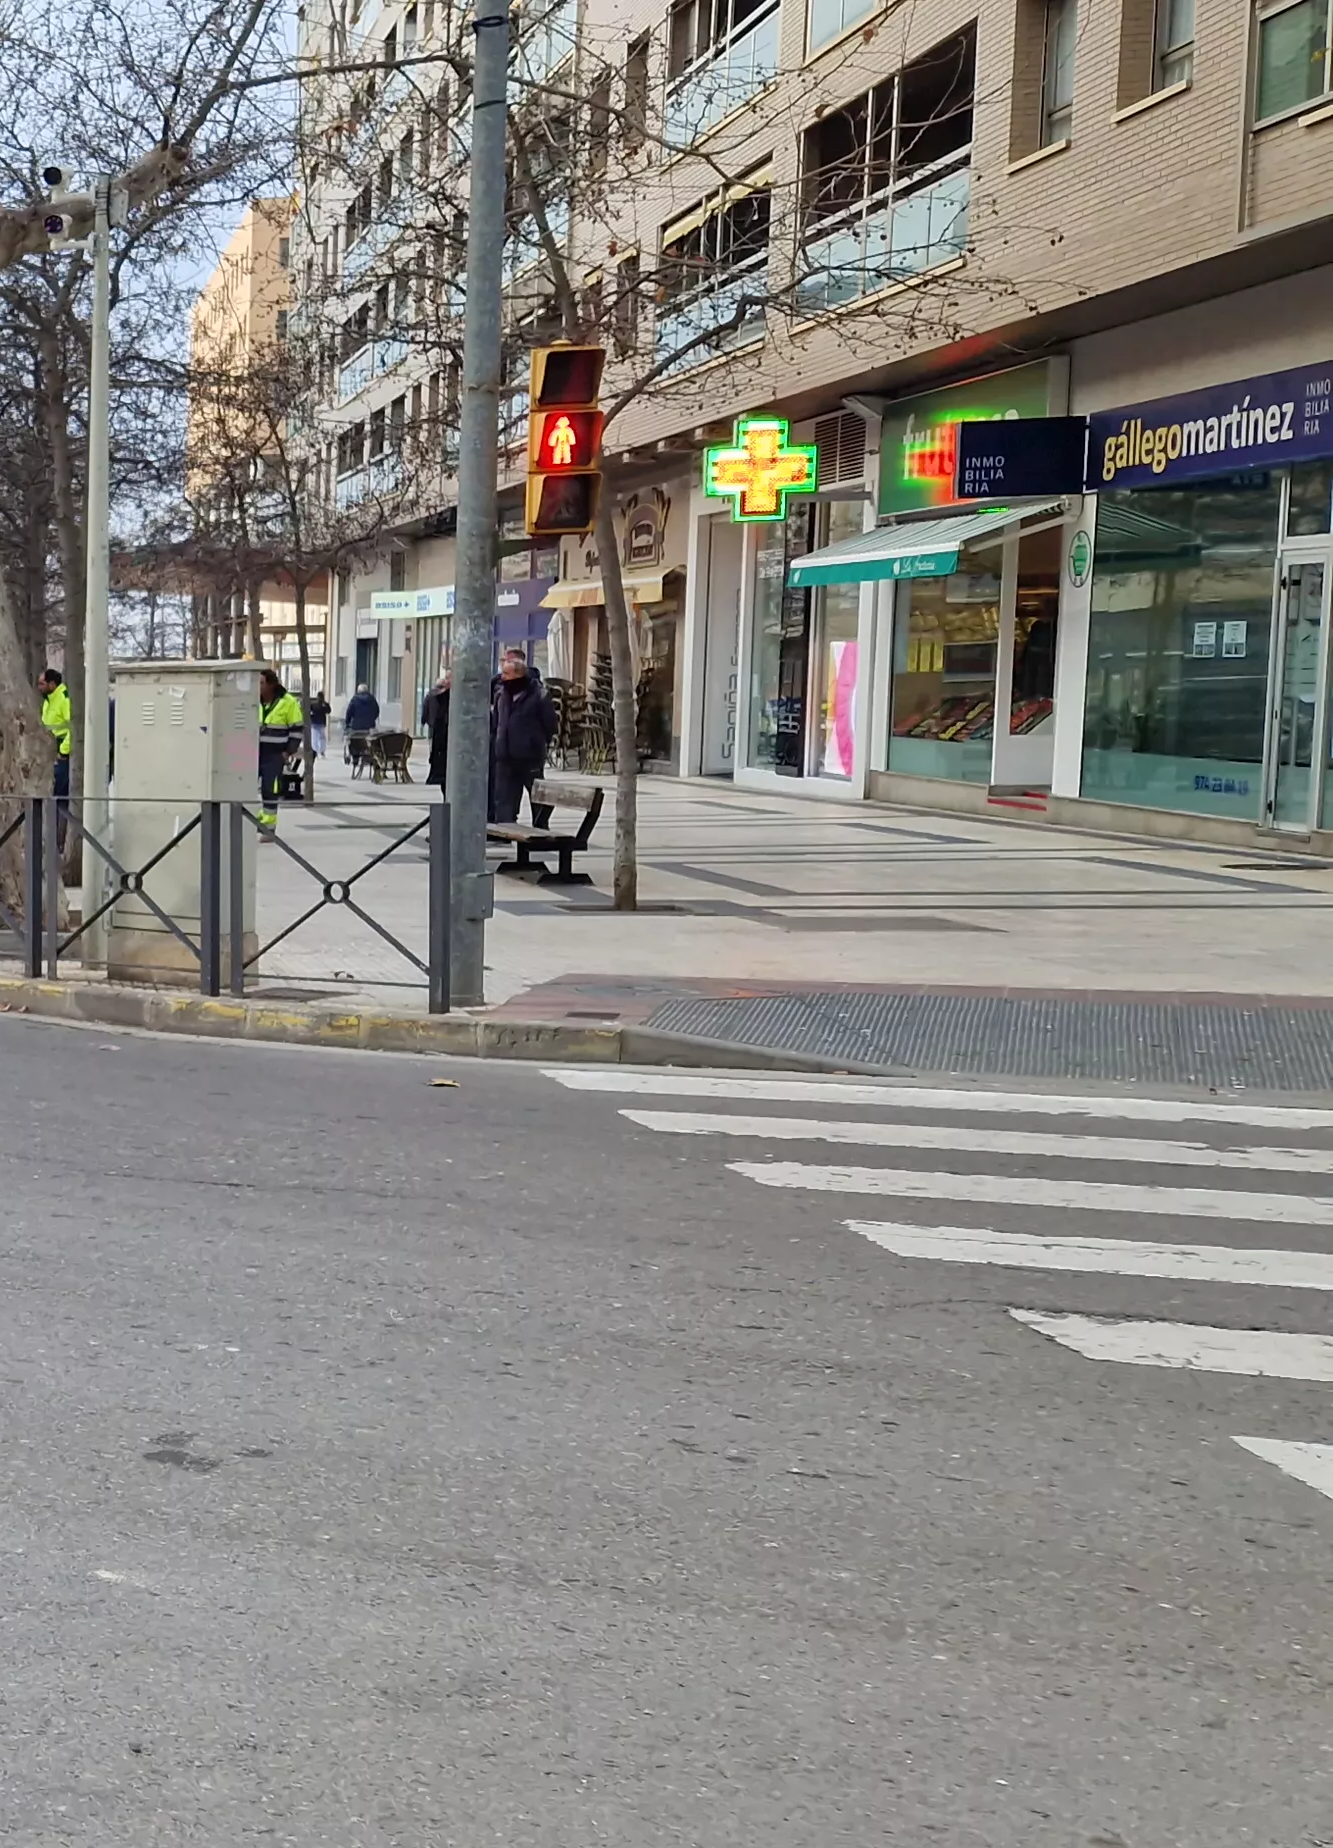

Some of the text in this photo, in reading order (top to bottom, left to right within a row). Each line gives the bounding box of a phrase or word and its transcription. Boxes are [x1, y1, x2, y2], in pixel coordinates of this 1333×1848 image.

[1306, 378, 1331, 397] INMO
[1305, 399, 1330, 418] BILIA
[1304, 424, 1320, 436] RIA
[966, 456, 1005, 468] INMO
[965, 469, 1004, 481] BILIA
[964, 482, 990, 493] RIA
